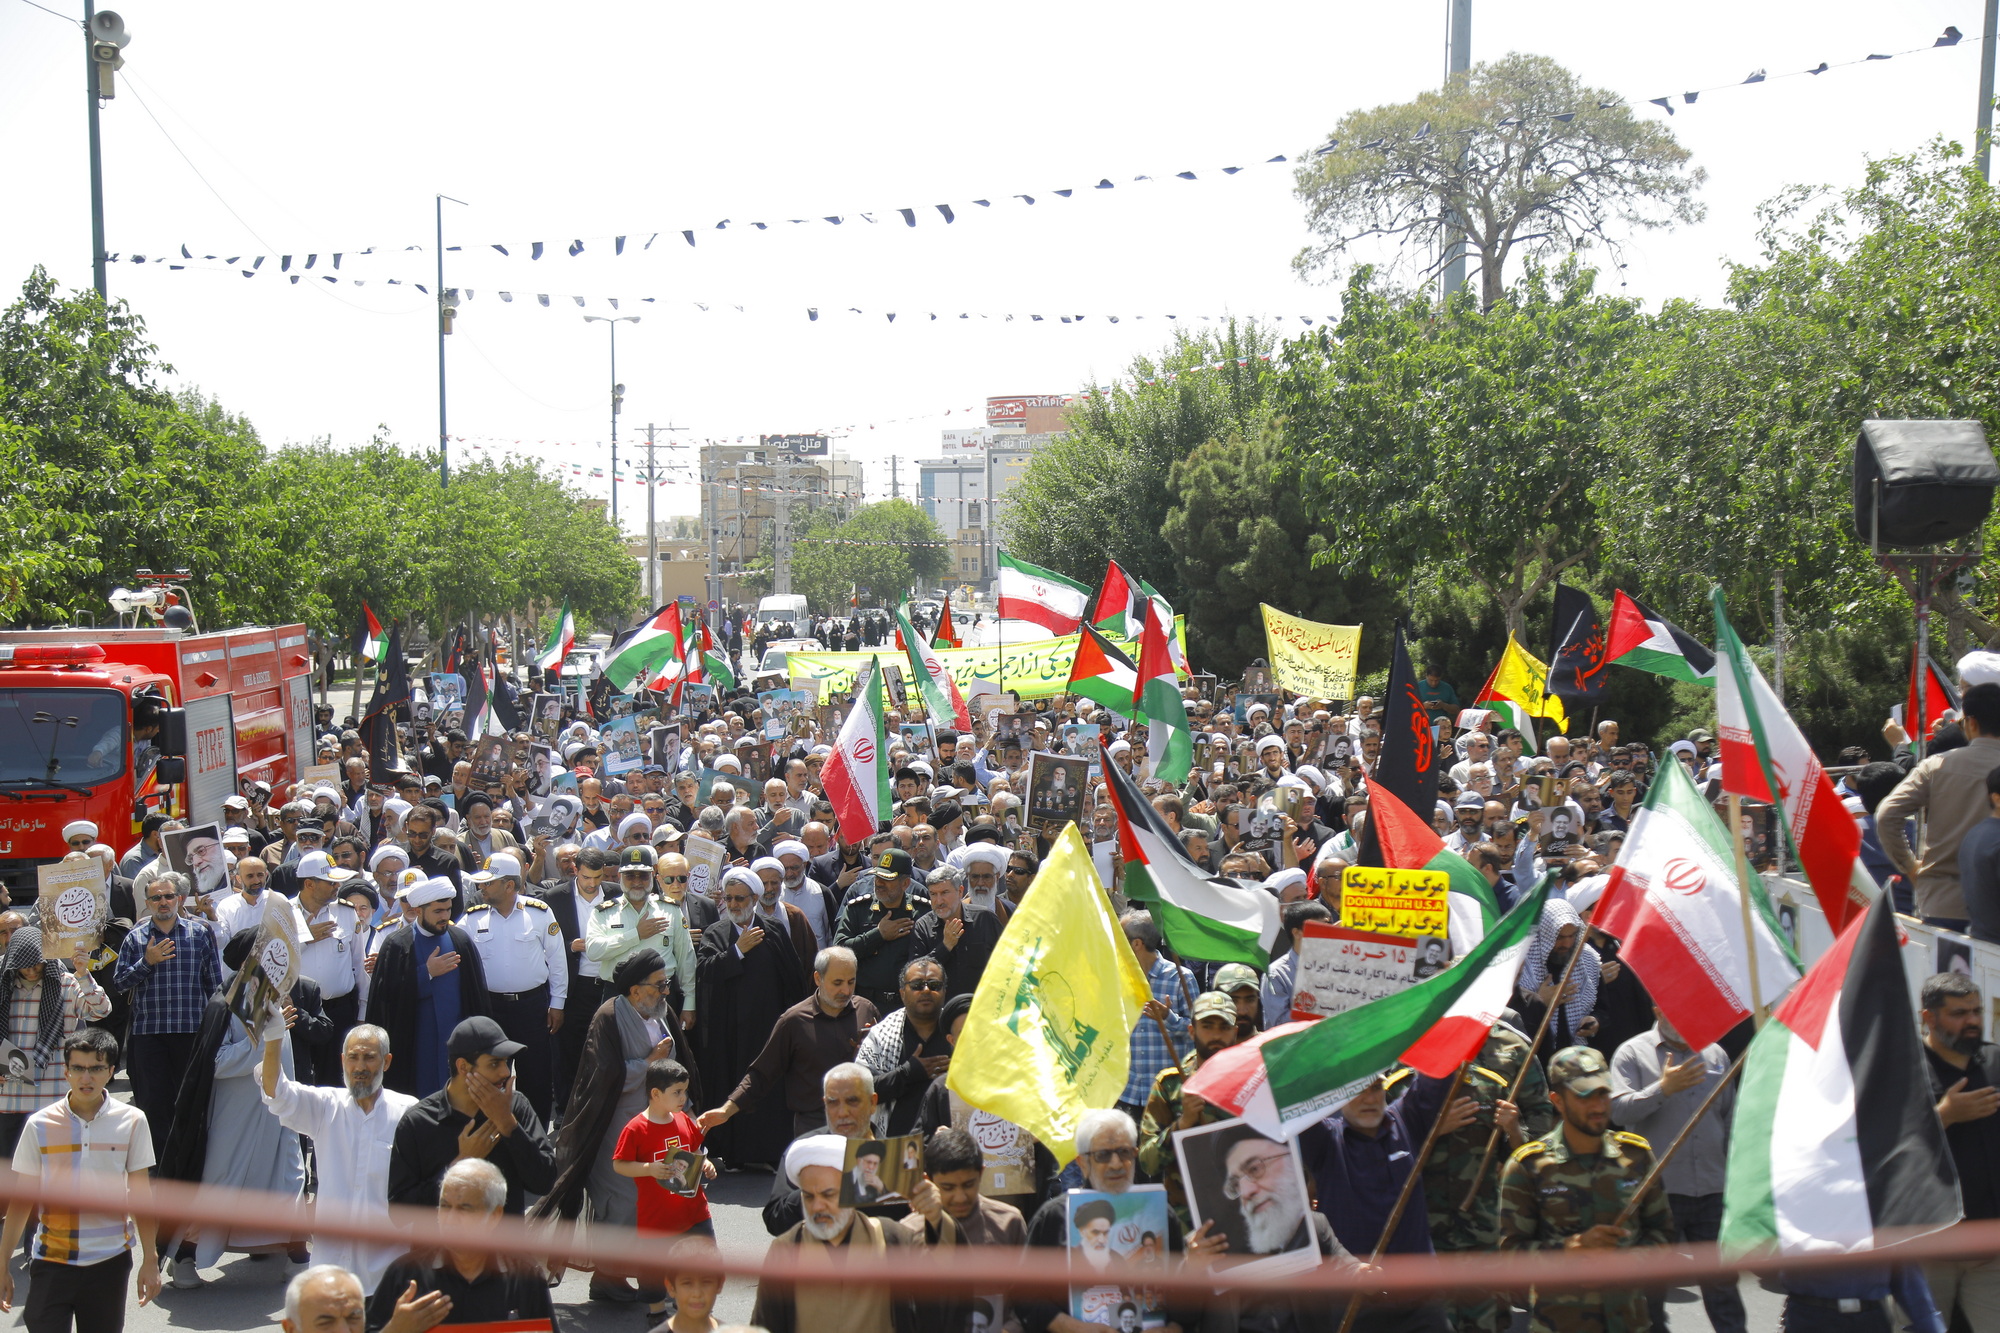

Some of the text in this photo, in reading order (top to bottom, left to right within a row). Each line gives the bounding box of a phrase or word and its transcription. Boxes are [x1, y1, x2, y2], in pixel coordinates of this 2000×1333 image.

[1026, 398, 1066, 408] OLYMPIC
[800, 438, 822, 452] هتل
[962, 435, 978, 448] صفا
[1298, 632, 1334, 654] المسلمون
[1025, 652, 1038, 676] از
[243, 674, 252, 687] FIRE
[256, 670, 270, 684] RESCUE
[1292, 674, 1315, 686] WITH
[1292, 684, 1315, 696] WITH
[1322, 692, 1348, 700] ISRAEL
[297, 698, 310, 729] 125
[196, 725, 227, 774] FIRE
[12, 818, 46, 832] سازمان
[1346, 871, 1445, 898] مرگ بر آمریکا
[1346, 896, 1444, 911] DOWN WITH U.S.A
[1344, 911, 1444, 936] مرگ بر اسرائیل
[1341, 943, 1407, 965] ۱۵ خرداد
[1304, 960, 1330, 972] ایران
[1332, 964, 1351, 974] ملت
[1354, 969, 1398, 981] فداکارانه
[1314, 982, 1334, 990] امت
[1336, 985, 1368, 1000] وحدت
